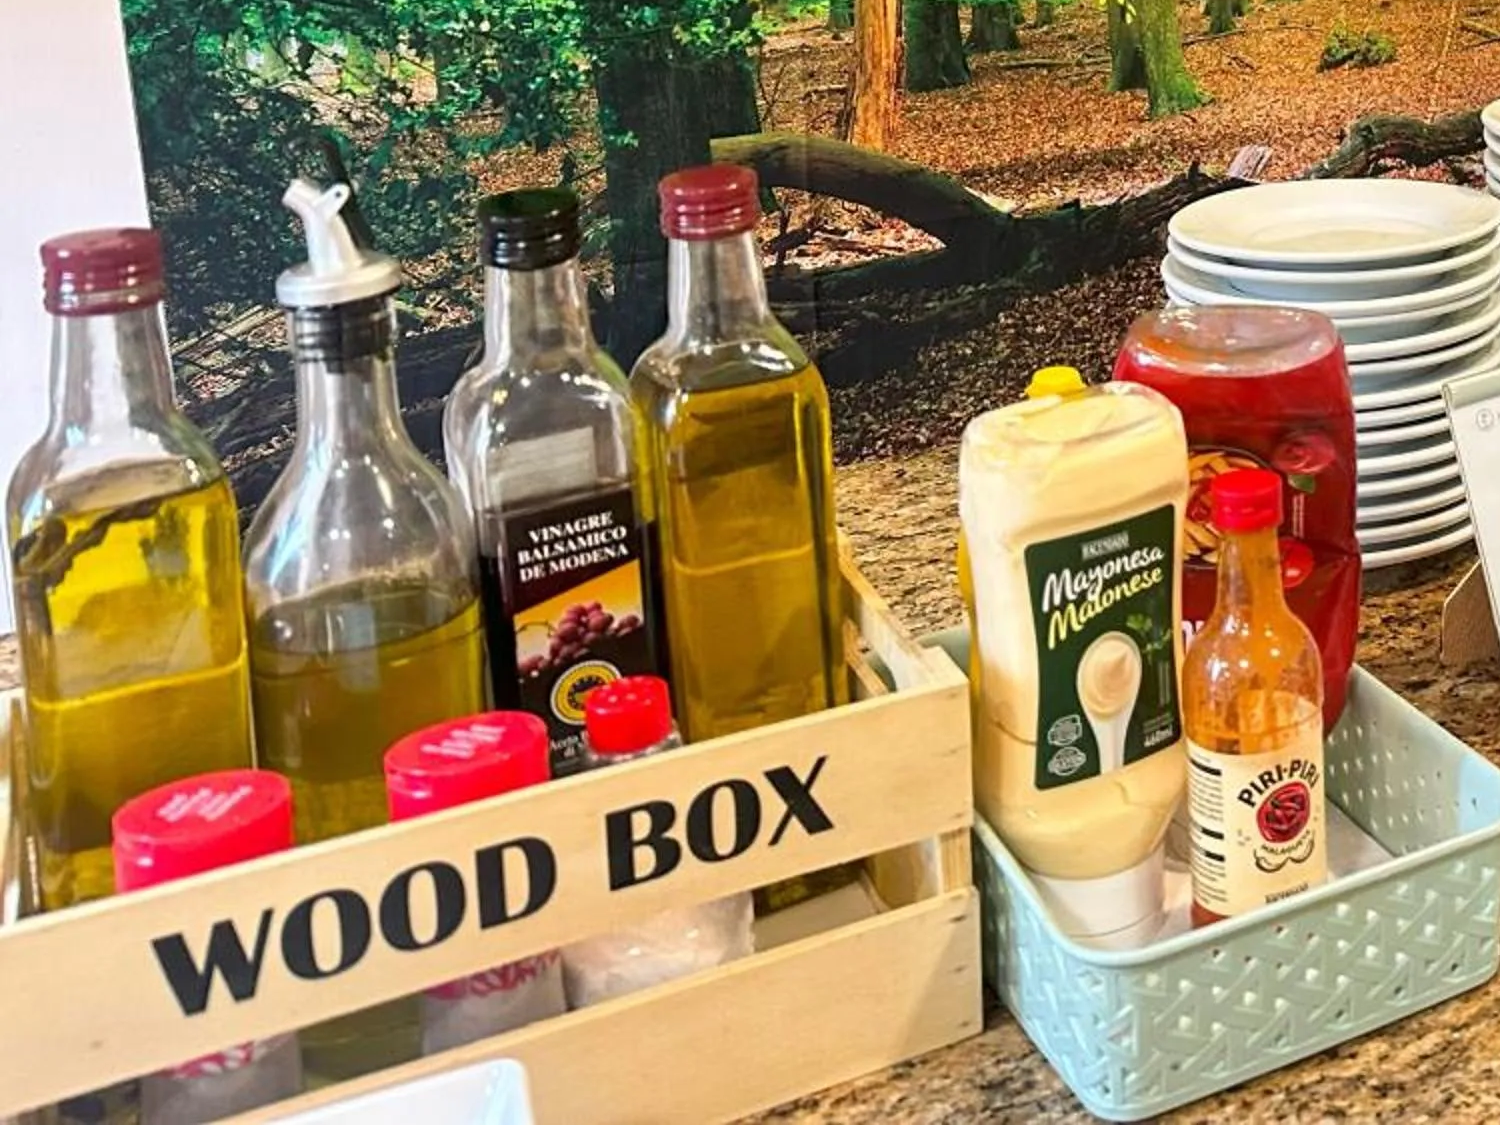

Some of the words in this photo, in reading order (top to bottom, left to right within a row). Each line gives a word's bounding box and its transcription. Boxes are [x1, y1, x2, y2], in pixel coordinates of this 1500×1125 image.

[517, 526, 627, 565] BALSAMICO
[528, 511, 613, 543] VINAGRE
[519, 563, 546, 583] DE
[550, 543, 629, 574] MODENA
[1041, 546, 1165, 613] Mayonesa
[151, 837, 558, 1018] WOOD
[605, 755, 836, 891] BOX
